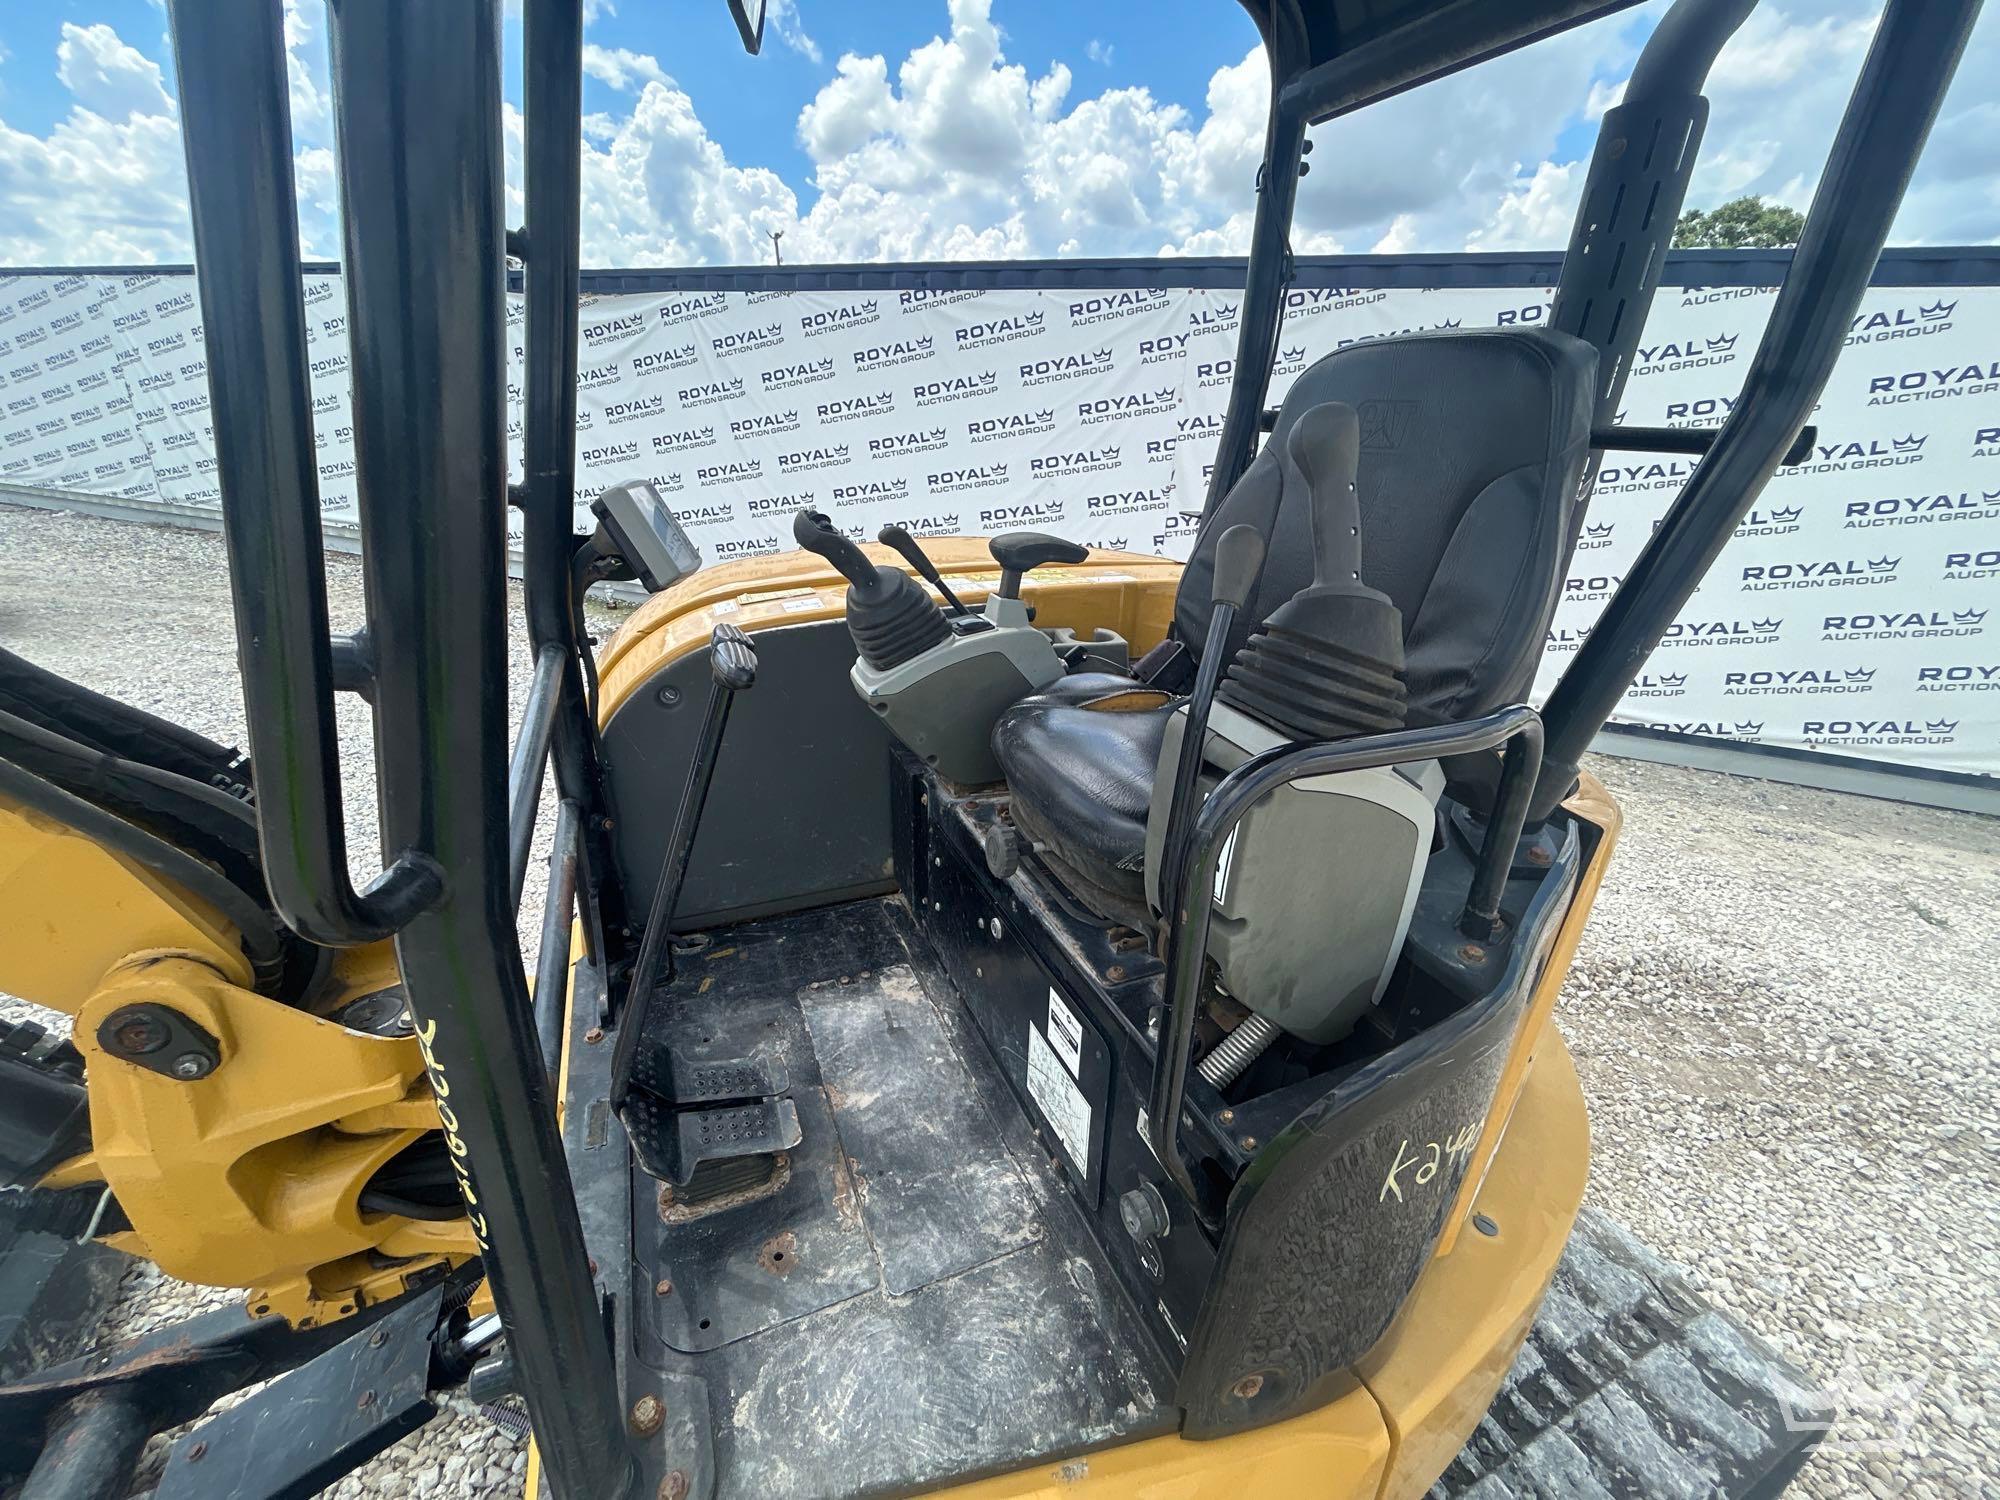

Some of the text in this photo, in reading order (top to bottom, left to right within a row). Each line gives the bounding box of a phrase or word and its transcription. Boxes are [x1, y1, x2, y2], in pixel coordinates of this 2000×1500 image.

[53, 275, 81, 293] ROYAL
[18, 290, 44, 308] ROYAL
[155, 294, 187, 313] ROYAL
[1069, 290, 1148, 318] ROYAL
[1335, 293, 1387, 310] GROUP
[1681, 287, 1767, 307] AUCTION
[659, 296, 713, 319] ROYAL
[902, 298, 947, 315] AUCTION
[1072, 300, 1170, 327] AUCTION GROUP
[50, 312, 77, 329] ROYAL
[112, 312, 141, 327] ROYAL
[664, 305, 729, 327] AUCTION GROUP
[801, 304, 865, 329] ROYAL
[583, 317, 634, 340] ROYAL
[804, 314, 880, 338] AUCTION GROUP
[955, 317, 1025, 342] ROYAL
[1193, 321, 1239, 336] GROUP
[1875, 322, 1952, 342] GROUP
[80, 335, 107, 352] ROYAL
[147, 333, 179, 351] ROYAL
[588, 327, 646, 347] AUCTION GROUP
[712, 328, 768, 350] ROYAL
[958, 326, 1046, 351] AUCTION GROUP
[716, 337, 784, 358] AUCTION GROUP
[853, 341, 917, 364] ROYAL
[44, 350, 71, 366] ROYAL
[311, 355, 346, 373] ROYAL
[633, 347, 685, 370] ROYAL
[637, 357, 698, 377] AUCTION GROUP
[857, 350, 935, 373] AUCTION GROUP
[1020, 354, 1093, 378] ROYAL
[1669, 354, 1735, 371] GROUP
[76, 371, 103, 387] ROYAL
[138, 371, 168, 388] ROYAL
[596, 376, 621, 387] GROUP
[761, 361, 821, 384] ROYAL
[765, 371, 836, 392] AUCTION GROUP
[1022, 364, 1114, 387] AUCTION GROUP
[41, 384, 68, 399] ROYAL
[678, 381, 732, 401] ROYAL
[913, 376, 979, 398] ROYAL
[170, 395, 203, 412] ROYAL
[682, 390, 746, 409] AUCTION GROUP
[917, 386, 998, 407] AUCTION GROUP
[1079, 393, 1155, 416] ROYAL
[1867, 387, 1963, 406] AUCTION
[70, 406, 97, 421] ROYAL
[605, 398, 653, 418] ROYAL
[609, 407, 665, 424] AUCTION GROUP
[817, 396, 877, 417] ROYAL
[820, 405, 895, 424] AUCTION GROUP
[1080, 403, 1177, 426] AUCTION GROUP
[730, 413, 786, 433] ROYAL
[734, 423, 800, 440] AUCTION GROUP
[968, 414, 1036, 435] ROYAL
[101, 428, 127, 442] ROYAL
[162, 430, 193, 445] ROYAL
[652, 429, 703, 448] ROYAL
[869, 431, 933, 451] ROYAL
[971, 424, 1055, 444] AUCTION GROUP
[66, 438, 92, 452] ROYAL
[582, 444, 629, 461] ROYAL
[656, 439, 717, 455] AUCTION GROUP
[872, 442, 949, 460] AUCTION GROUP
[33, 448, 58, 462] ROYAL
[586, 453, 640, 468] AUCTION GROUP
[778, 447, 836, 466] ROYAL
[1030, 451, 1101, 471] ROYAL
[1851, 455, 1923, 469] GROUP
[94, 461, 120, 474] ROYAL
[319, 461, 354, 475] ROYAL
[697, 462, 750, 479] ROYAL
[781, 457, 851, 474] AUCTION GROUP
[1033, 461, 1122, 480] AUCTION GROUP
[1599, 462, 1686, 484] OYAL
[60, 470, 85, 483] ROYAL
[701, 472, 763, 487] AUCTION GROUP
[927, 467, 991, 486] ROYAL
[930, 477, 1009, 494] AUCTION GROUP
[123, 482, 150, 495] ROYAL
[659, 485, 684, 493] GROUP
[833, 482, 892, 499] ROYAL
[748, 494, 802, 511] ROYAL
[836, 492, 909, 507] AUCTION GROUP
[1087, 489, 1161, 509] ROYAL
[1845, 493, 1978, 517] ROYAL
[708, 516, 734, 524] GROUP
[752, 509, 787, 518] AUCTION
[980, 504, 1046, 522] ROYAL
[1089, 506, 1139, 517] AUCTION
[1843, 509, 1999, 529] AUCTION GROU
[934, 527, 961, 535] GROUP
[982, 514, 1065, 530] AUCTION GROUP
[1734, 525, 1800, 537] GROUP
[715, 539, 768, 553] ROYAL
[719, 548, 780, 560] AUCTION GROUP
[1742, 560, 1864, 581] ROYAL
[1741, 575, 1897, 591] AUCTION GROUP
[1823, 612, 1949, 630] ROYAL
[1717, 636, 1780, 645] GROUP
[1821, 628, 1983, 641] AUCTION GROUP
[1725, 670, 1841, 685] ROYAL
[1628, 689, 1685, 697] GROUP
[1723, 685, 1872, 695] AUCTION GROUP
[1803, 721, 1922, 734] ROYAL
[1800, 737, 1883, 745] AUCTION
